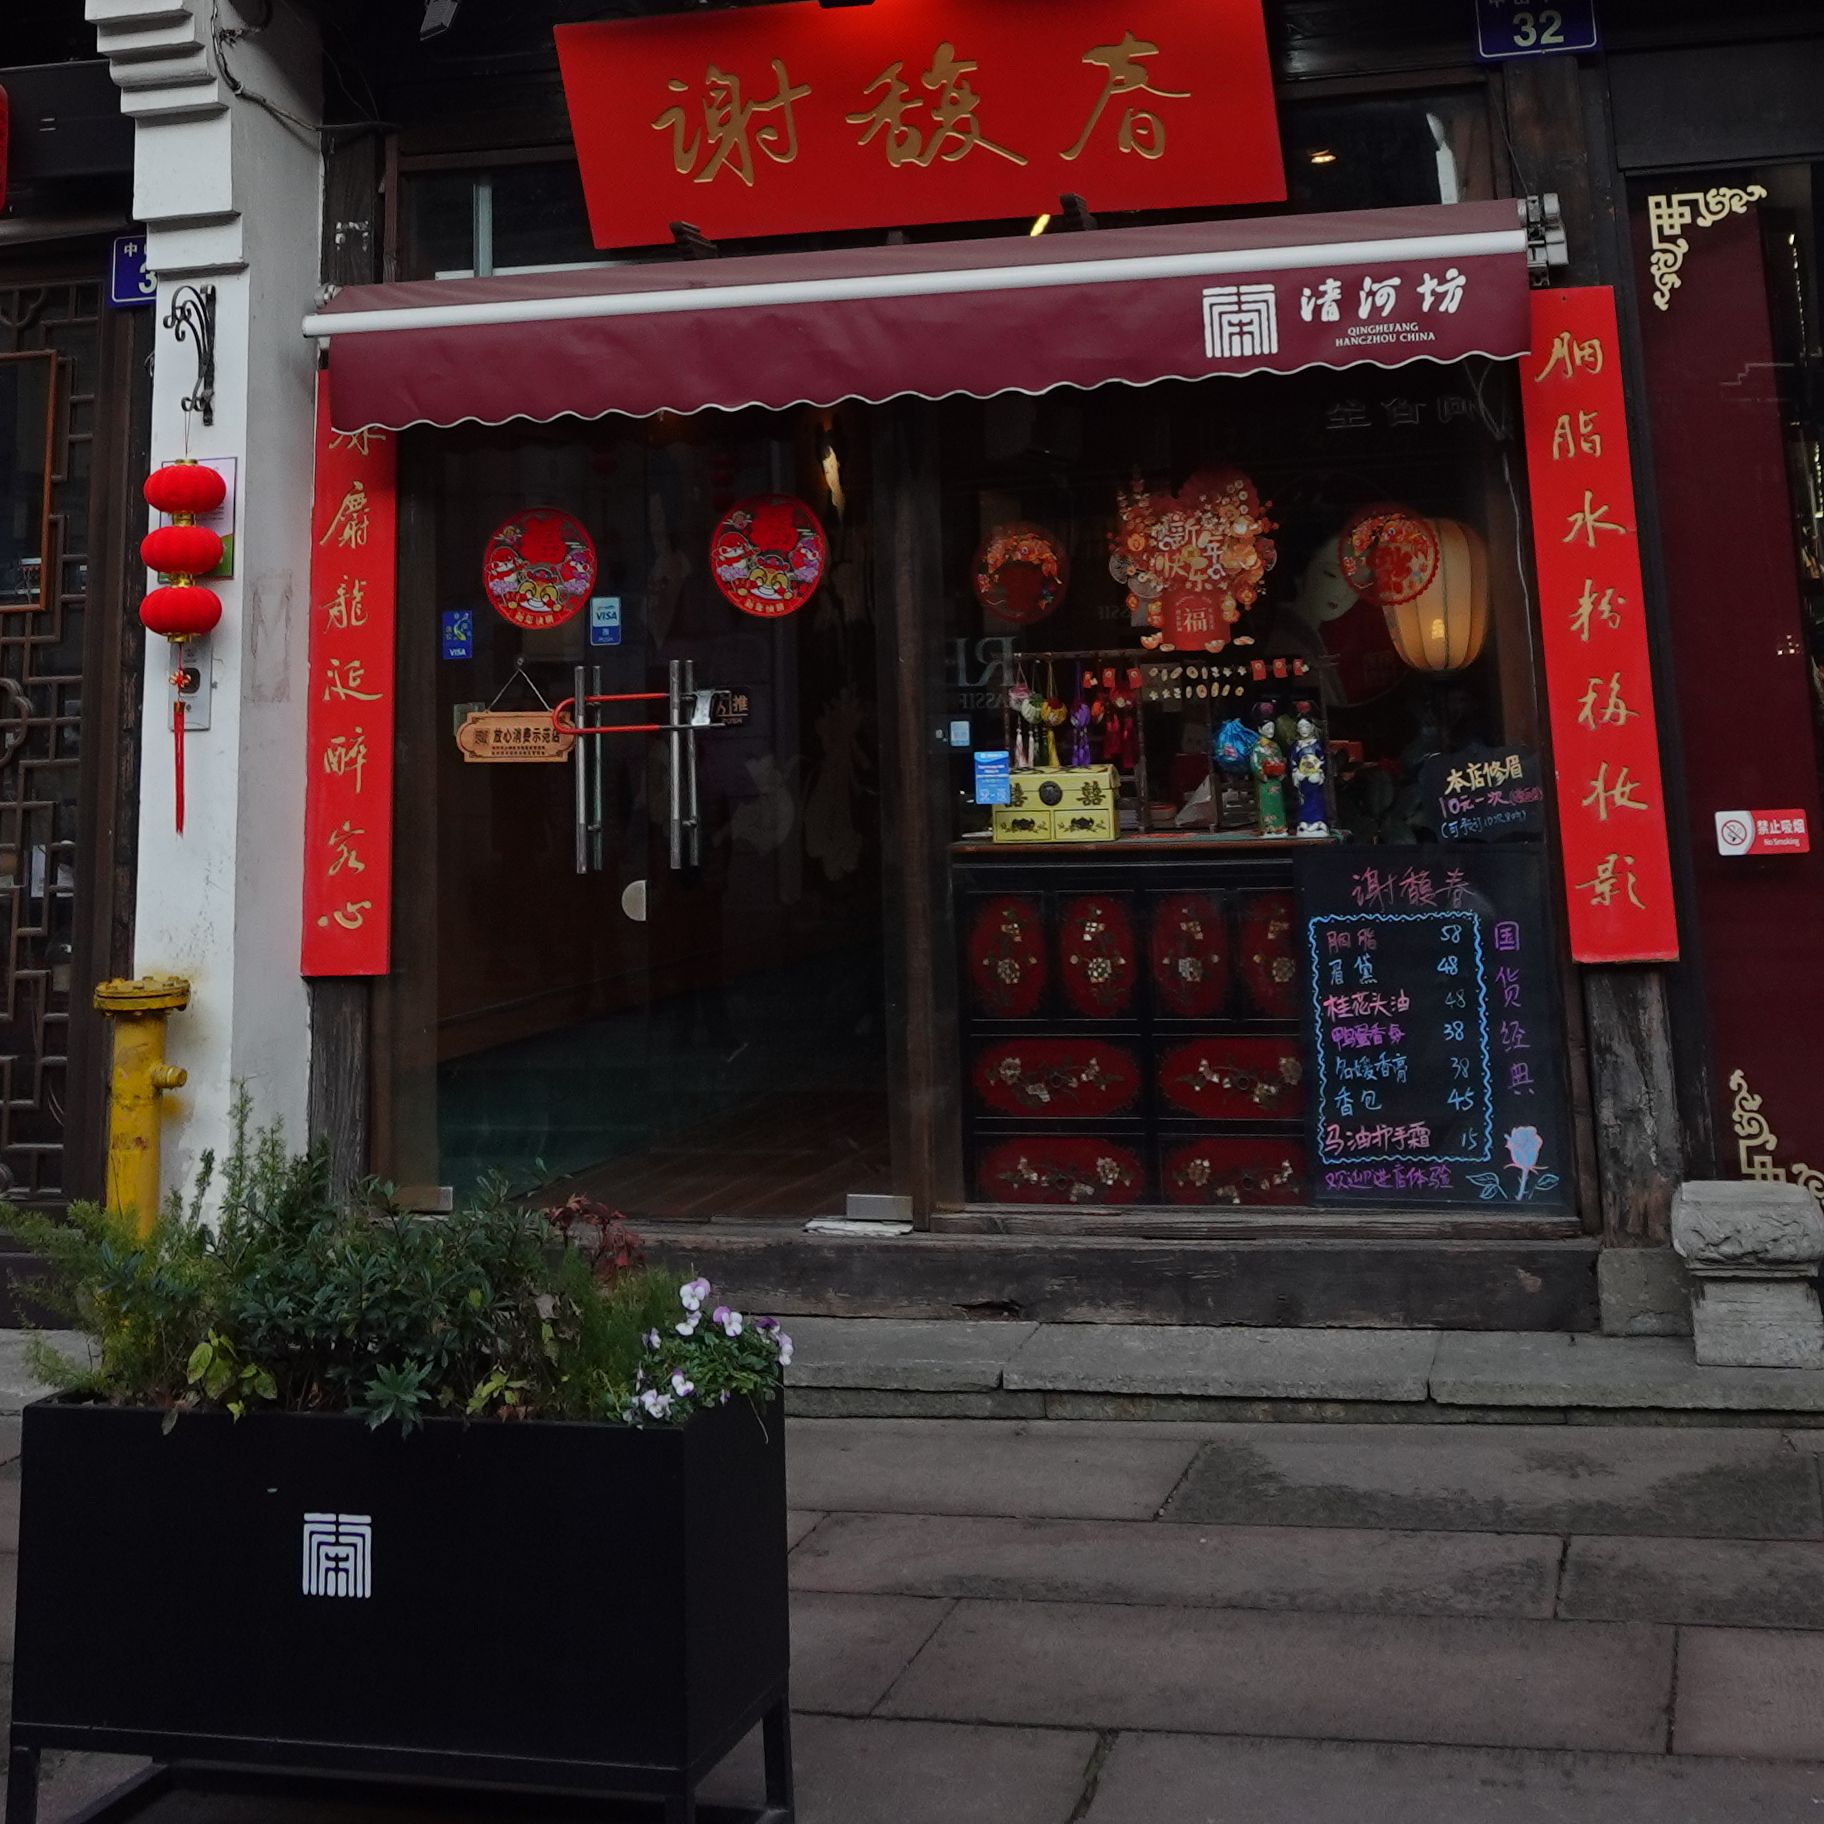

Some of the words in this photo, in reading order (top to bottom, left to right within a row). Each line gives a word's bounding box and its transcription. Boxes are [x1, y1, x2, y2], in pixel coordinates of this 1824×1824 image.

[1512, 9, 1565, 48] 32
[651, 30, 1192, 188] 谢馥春
[1299, 267, 1467, 323] 清河坊
[1347, 322, 1419, 336] QINGHEFANG
[1399, 332, 1436, 344] CHINA
[595, 609, 619, 622] VISA
[1184, 607, 1209, 634] 福
[448, 647, 467, 659] VISA
[492, 726, 561, 745] 放心消费示范店
[1444, 754, 1524, 795] 本店修眉
[1756, 818, 1806, 836] 禁止吸烟
[1351, 866, 1475, 909] 谢馥春
[1326, 927, 1377, 954] 胭脂
[1440, 924, 1462, 944] 58
[1328, 952, 1378, 985] 眉黛
[1436, 955, 1459, 976] 48
[1323, 988, 1411, 1022] 桂花头油
[1444, 988, 1467, 1010] 48
[1494, 920, 1536, 1095] 国货经典
[1443, 1020, 1465, 1041] 38
[1450, 1057, 1470, 1079] 38
[1334, 1085, 1382, 1117] 香包
[1446, 1087, 1475, 1111] 45
[1324, 1121, 1430, 1156] 马油护手霜
[1461, 1127, 1479, 1151] 15
